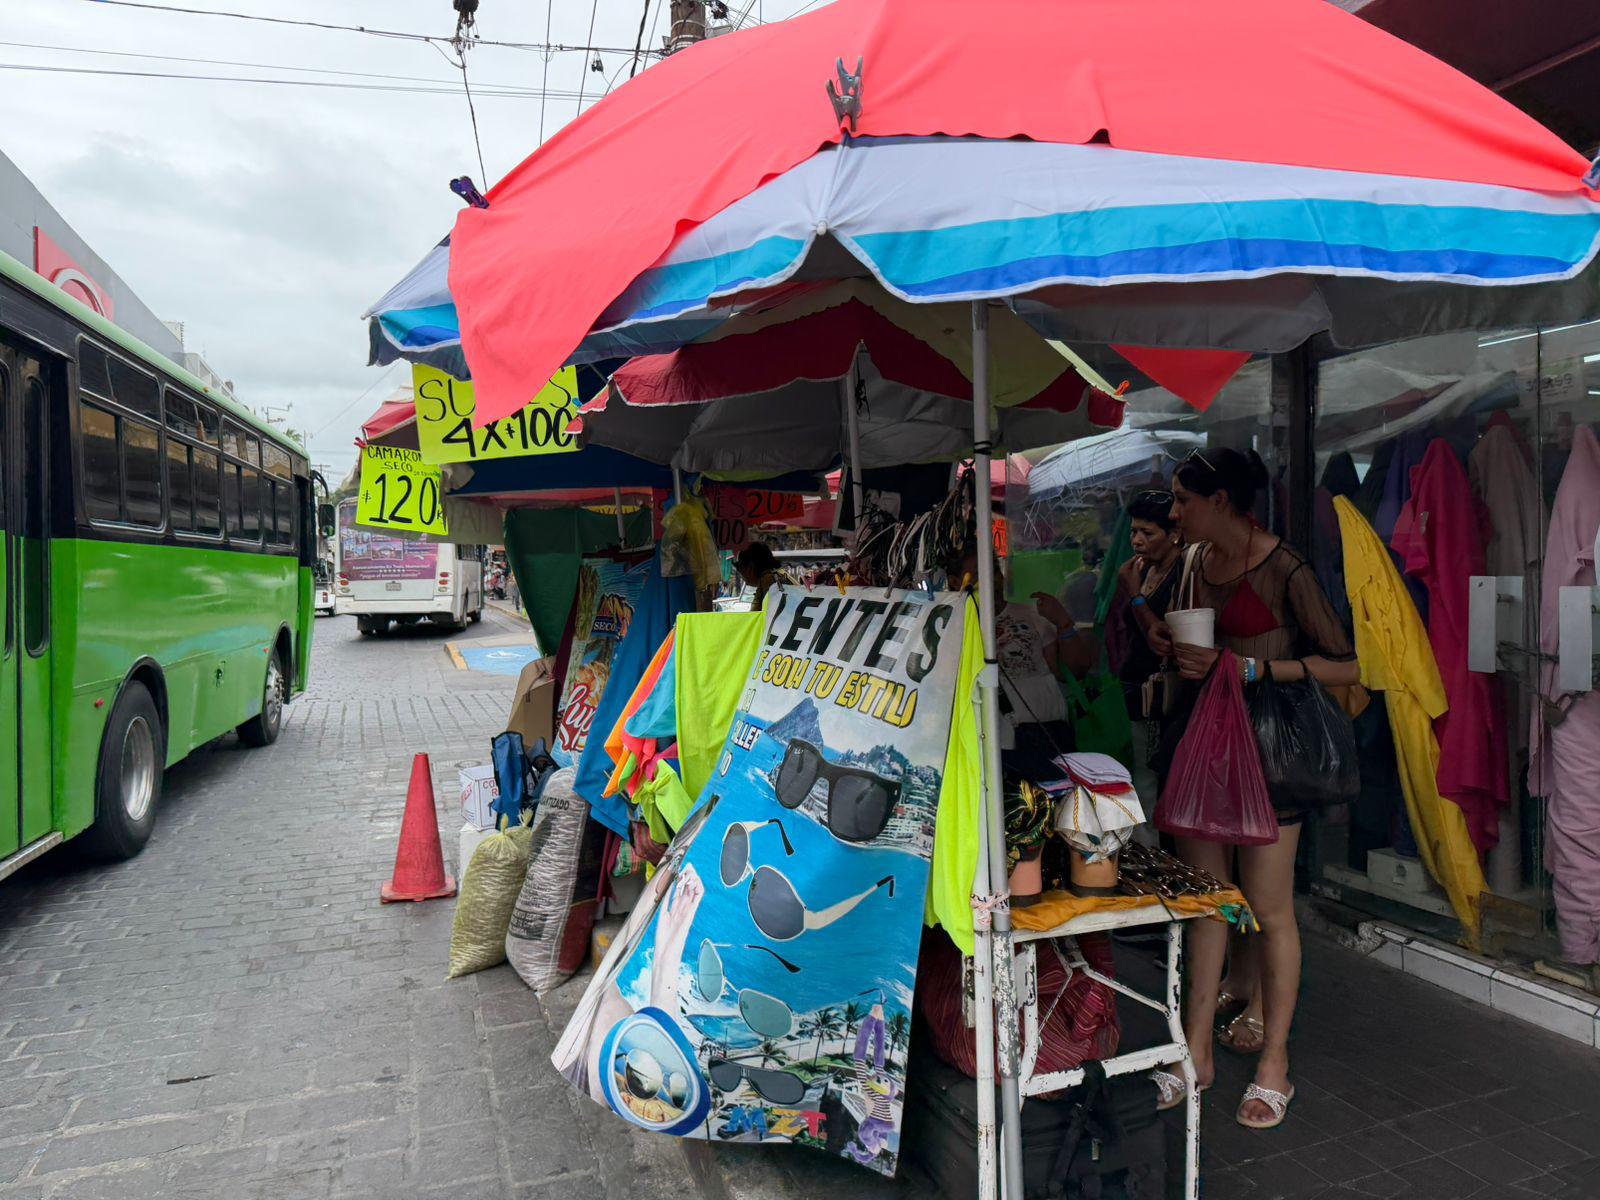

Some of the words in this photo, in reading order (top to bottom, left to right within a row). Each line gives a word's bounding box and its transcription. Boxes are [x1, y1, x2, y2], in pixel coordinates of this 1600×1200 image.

[382, 461, 413, 473] SECO
[766, 593, 954, 684] LENTES
[805, 661, 843, 699] TU
[725, 1104, 828, 1138] MZT
